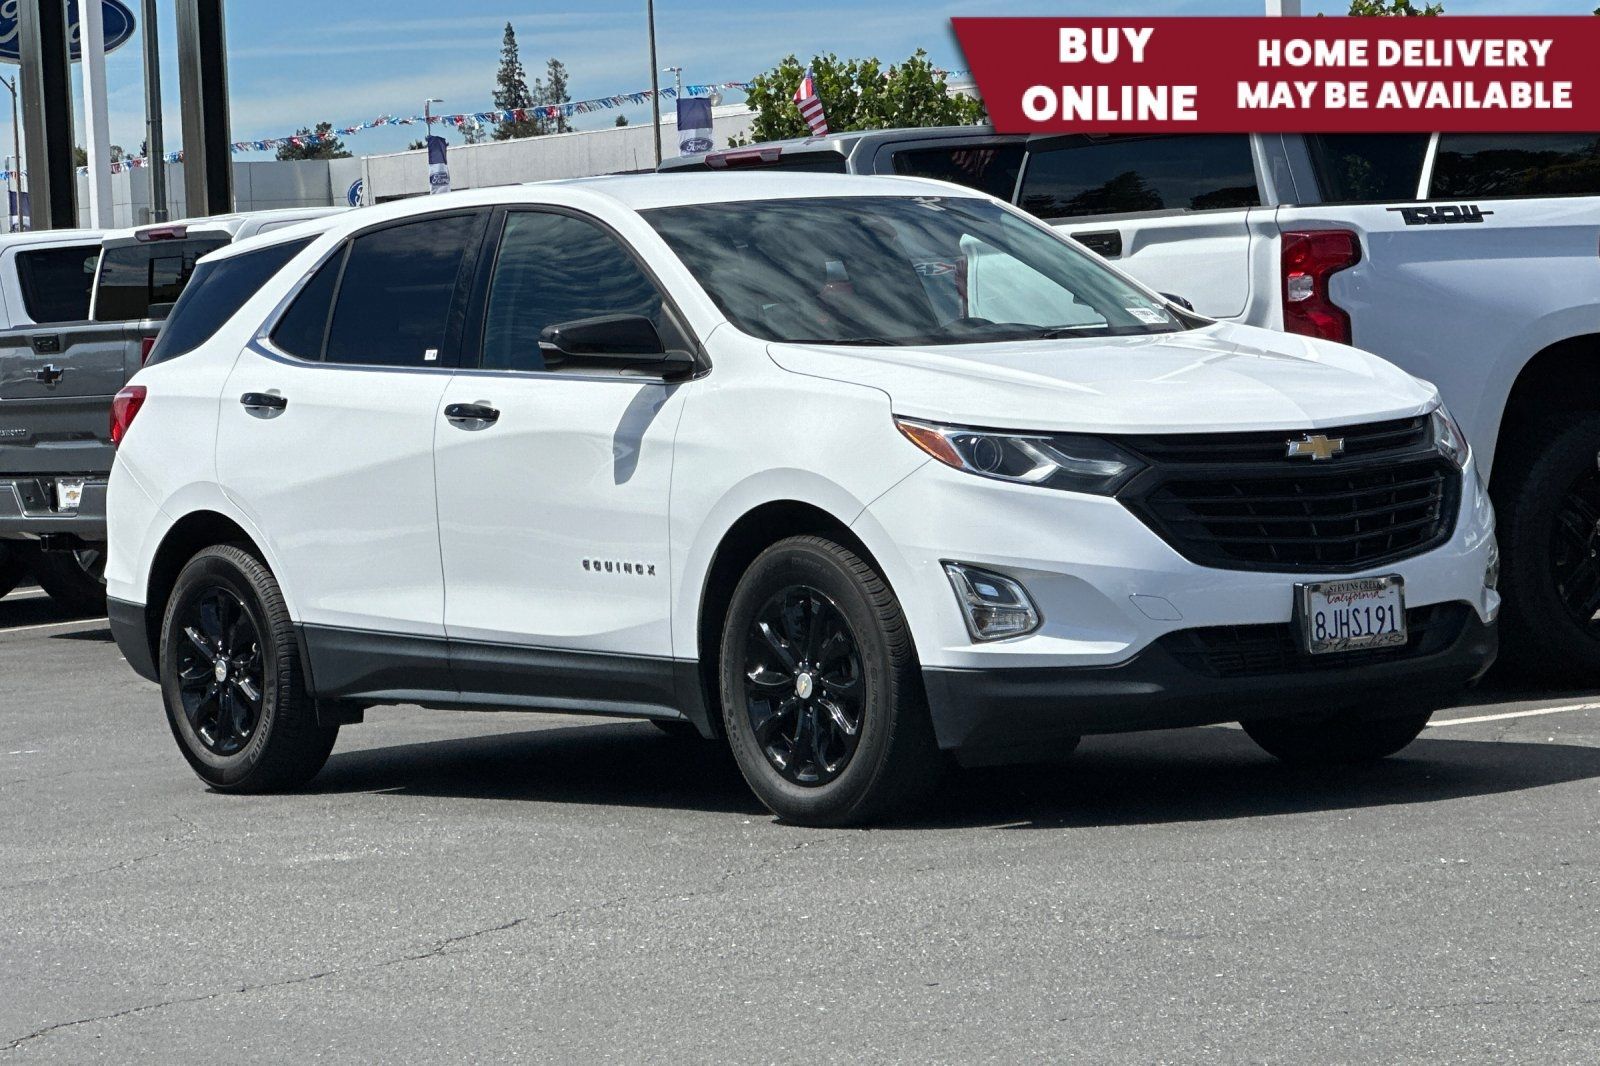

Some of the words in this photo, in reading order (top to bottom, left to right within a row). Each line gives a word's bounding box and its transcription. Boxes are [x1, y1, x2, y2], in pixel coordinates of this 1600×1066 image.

[582, 559, 656, 576] EQUINOX
[1327, 590, 1385, 606] California
[1315, 605, 1399, 640] 8JHS191
